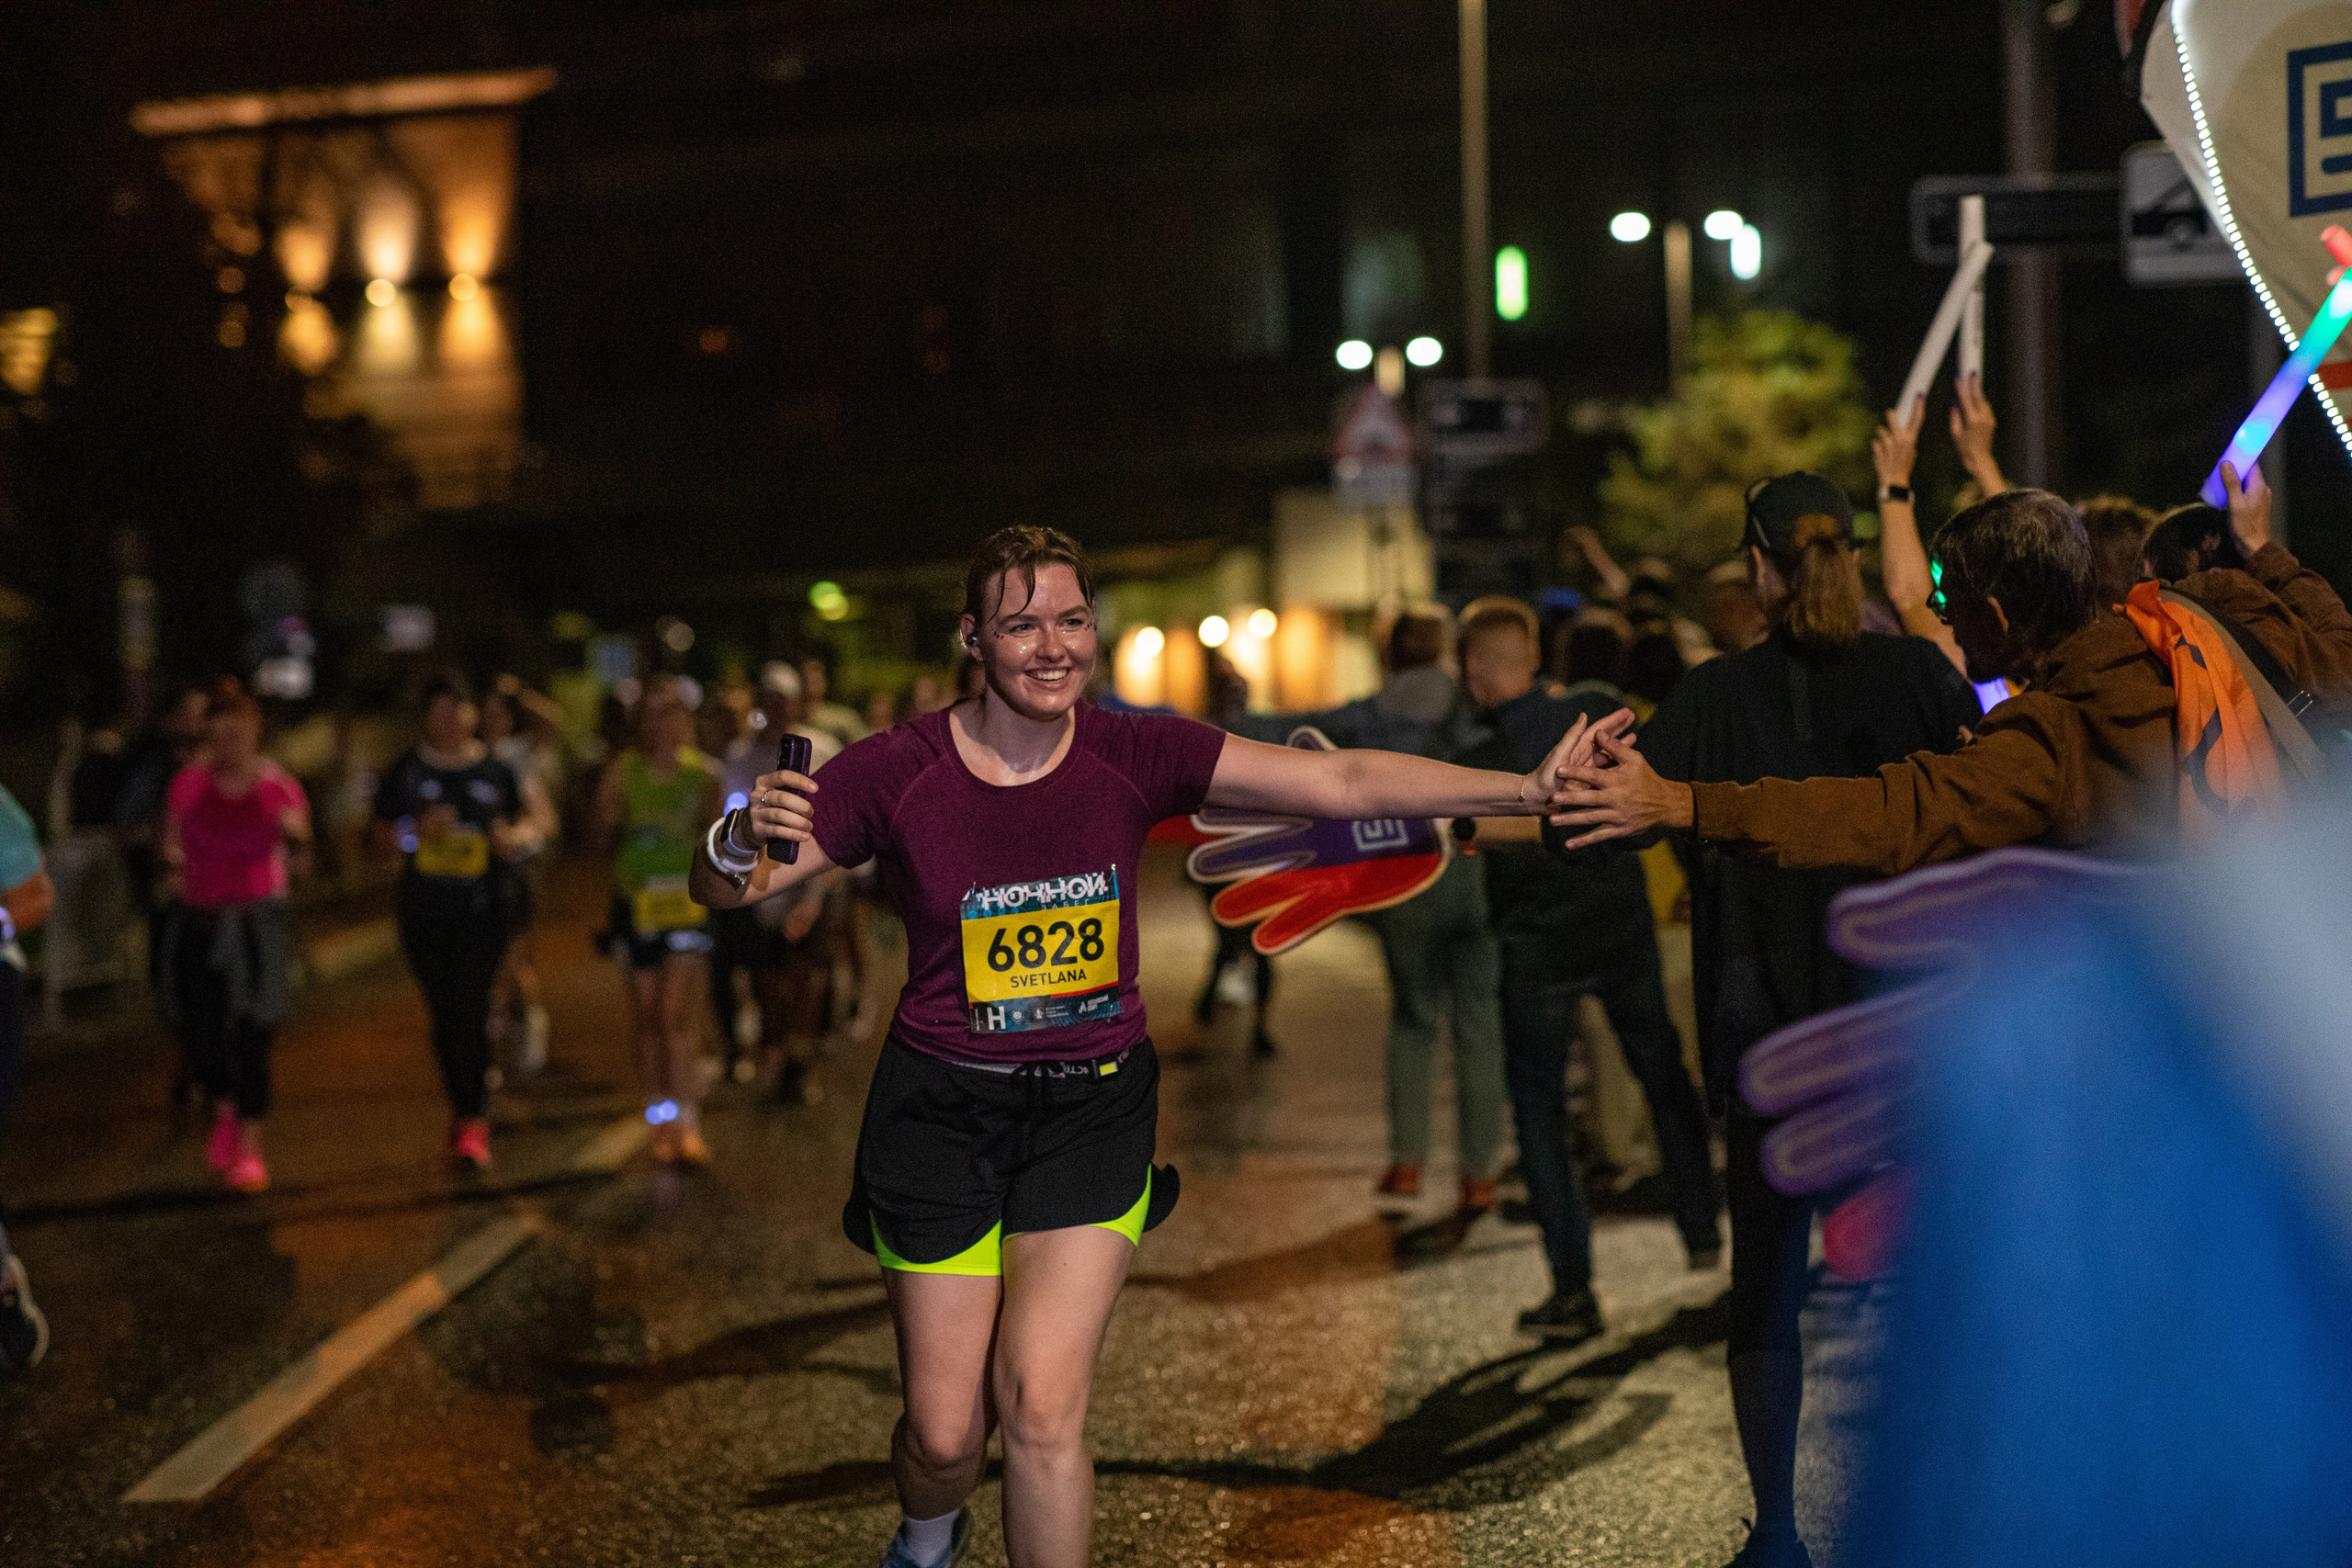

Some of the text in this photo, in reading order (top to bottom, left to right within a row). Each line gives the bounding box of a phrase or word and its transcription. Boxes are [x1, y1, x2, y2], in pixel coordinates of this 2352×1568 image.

[977, 872, 1108, 909] НОЧНОЙ
[1041, 898, 1090, 910] ЗАБЕГ
[988, 918, 1104, 972] 6828
[1010, 968, 1087, 988] SVETLANA
